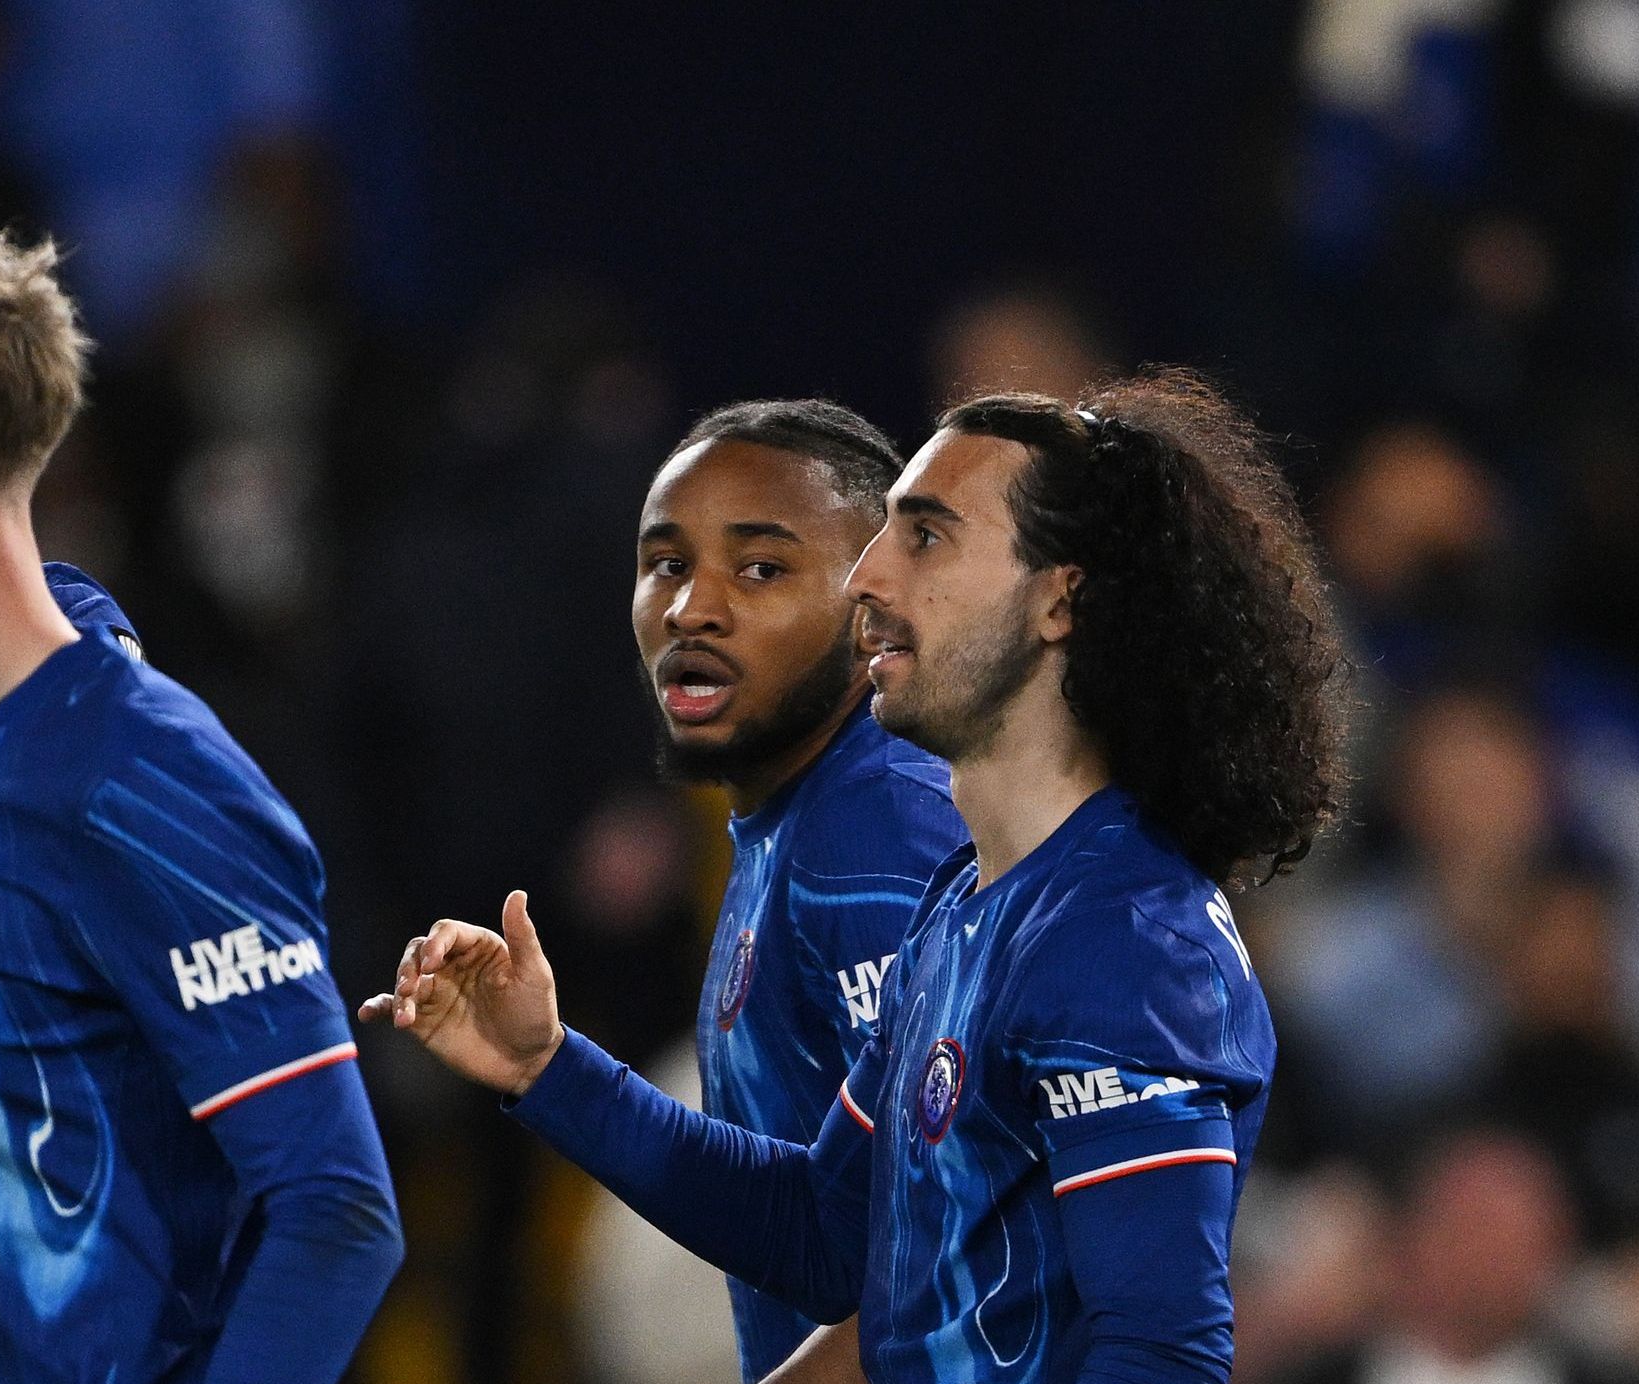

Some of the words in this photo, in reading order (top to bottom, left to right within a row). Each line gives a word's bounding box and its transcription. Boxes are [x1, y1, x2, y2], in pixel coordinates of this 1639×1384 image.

[169, 922, 265, 979] LIVE
[177, 937, 325, 1011] NATION
[837, 952, 899, 1000] LIV
[1039, 1066, 1125, 1104] LIVE
